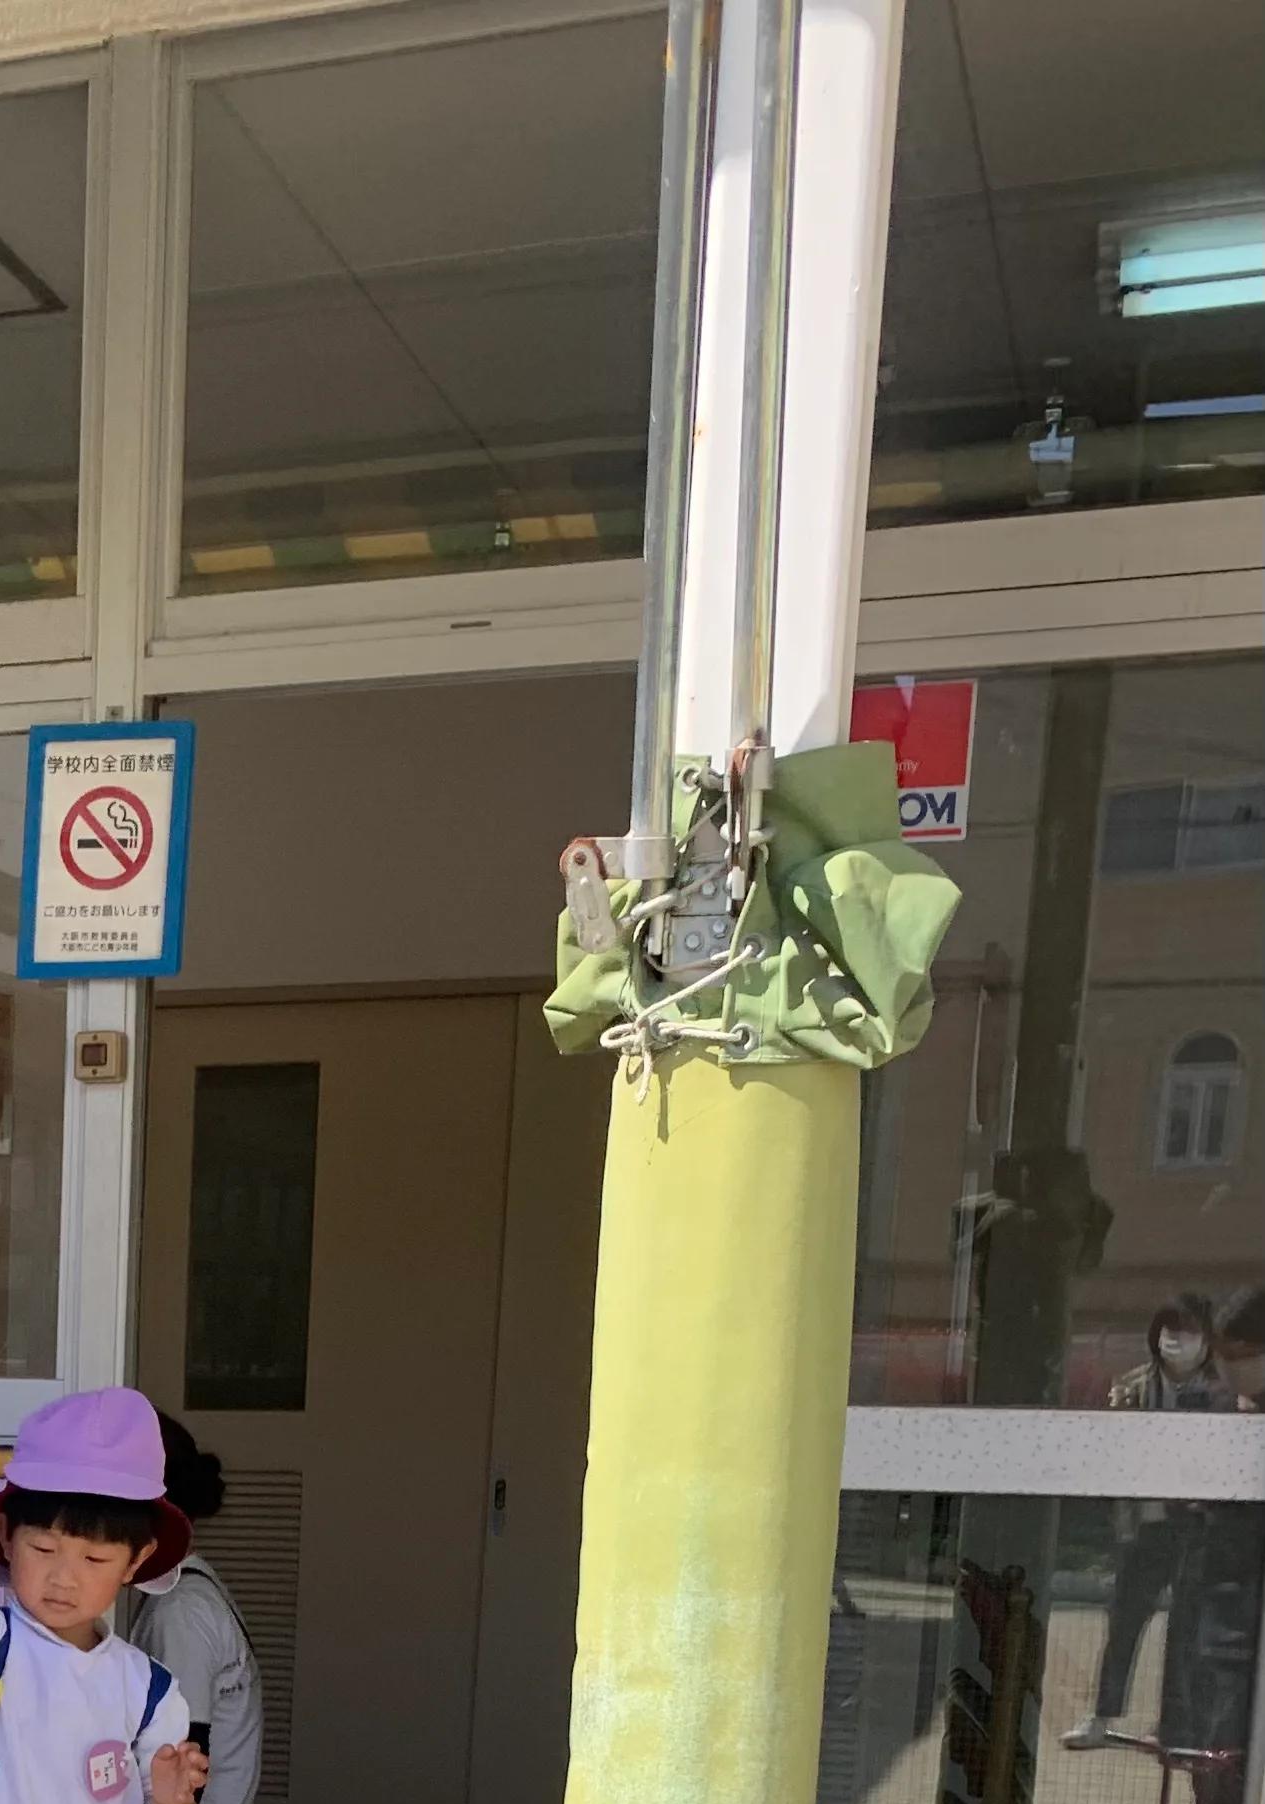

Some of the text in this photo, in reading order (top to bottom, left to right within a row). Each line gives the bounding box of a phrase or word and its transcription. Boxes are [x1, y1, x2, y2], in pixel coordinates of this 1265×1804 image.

[47, 753, 175, 774] 学校内全面禁煙
[43, 903, 162, 918] ご協力をお願いします
